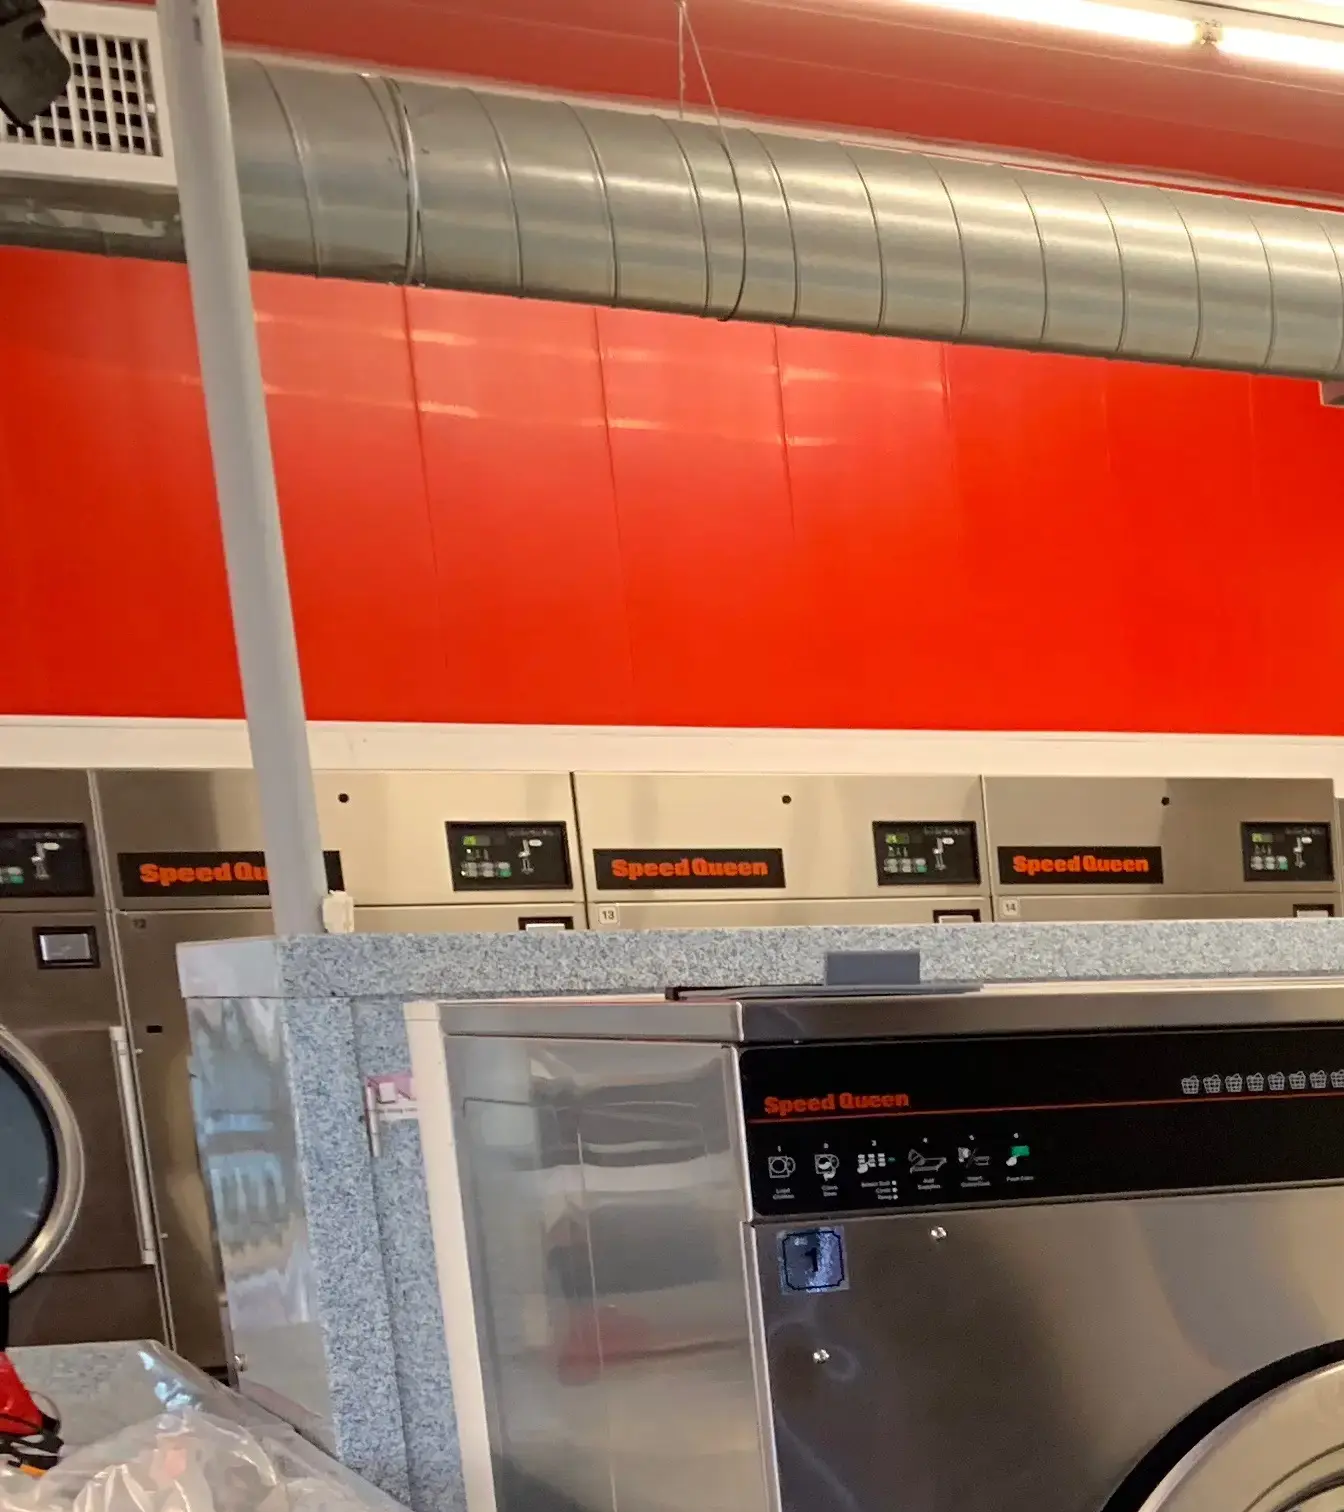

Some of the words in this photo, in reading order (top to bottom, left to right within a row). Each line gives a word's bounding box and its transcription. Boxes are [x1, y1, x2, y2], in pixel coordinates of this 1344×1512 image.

[139, 862, 233, 887] Speed
[611, 858, 690, 881] Speed
[692, 857, 769, 877] Queen
[1012, 855, 1082, 876] Speed
[1083, 854, 1149, 873] Queen
[602, 910, 615, 921] 13
[764, 1093, 836, 1116] Speed
[839, 1091, 910, 1110] Queen
[804, 1246, 819, 1273] 1
